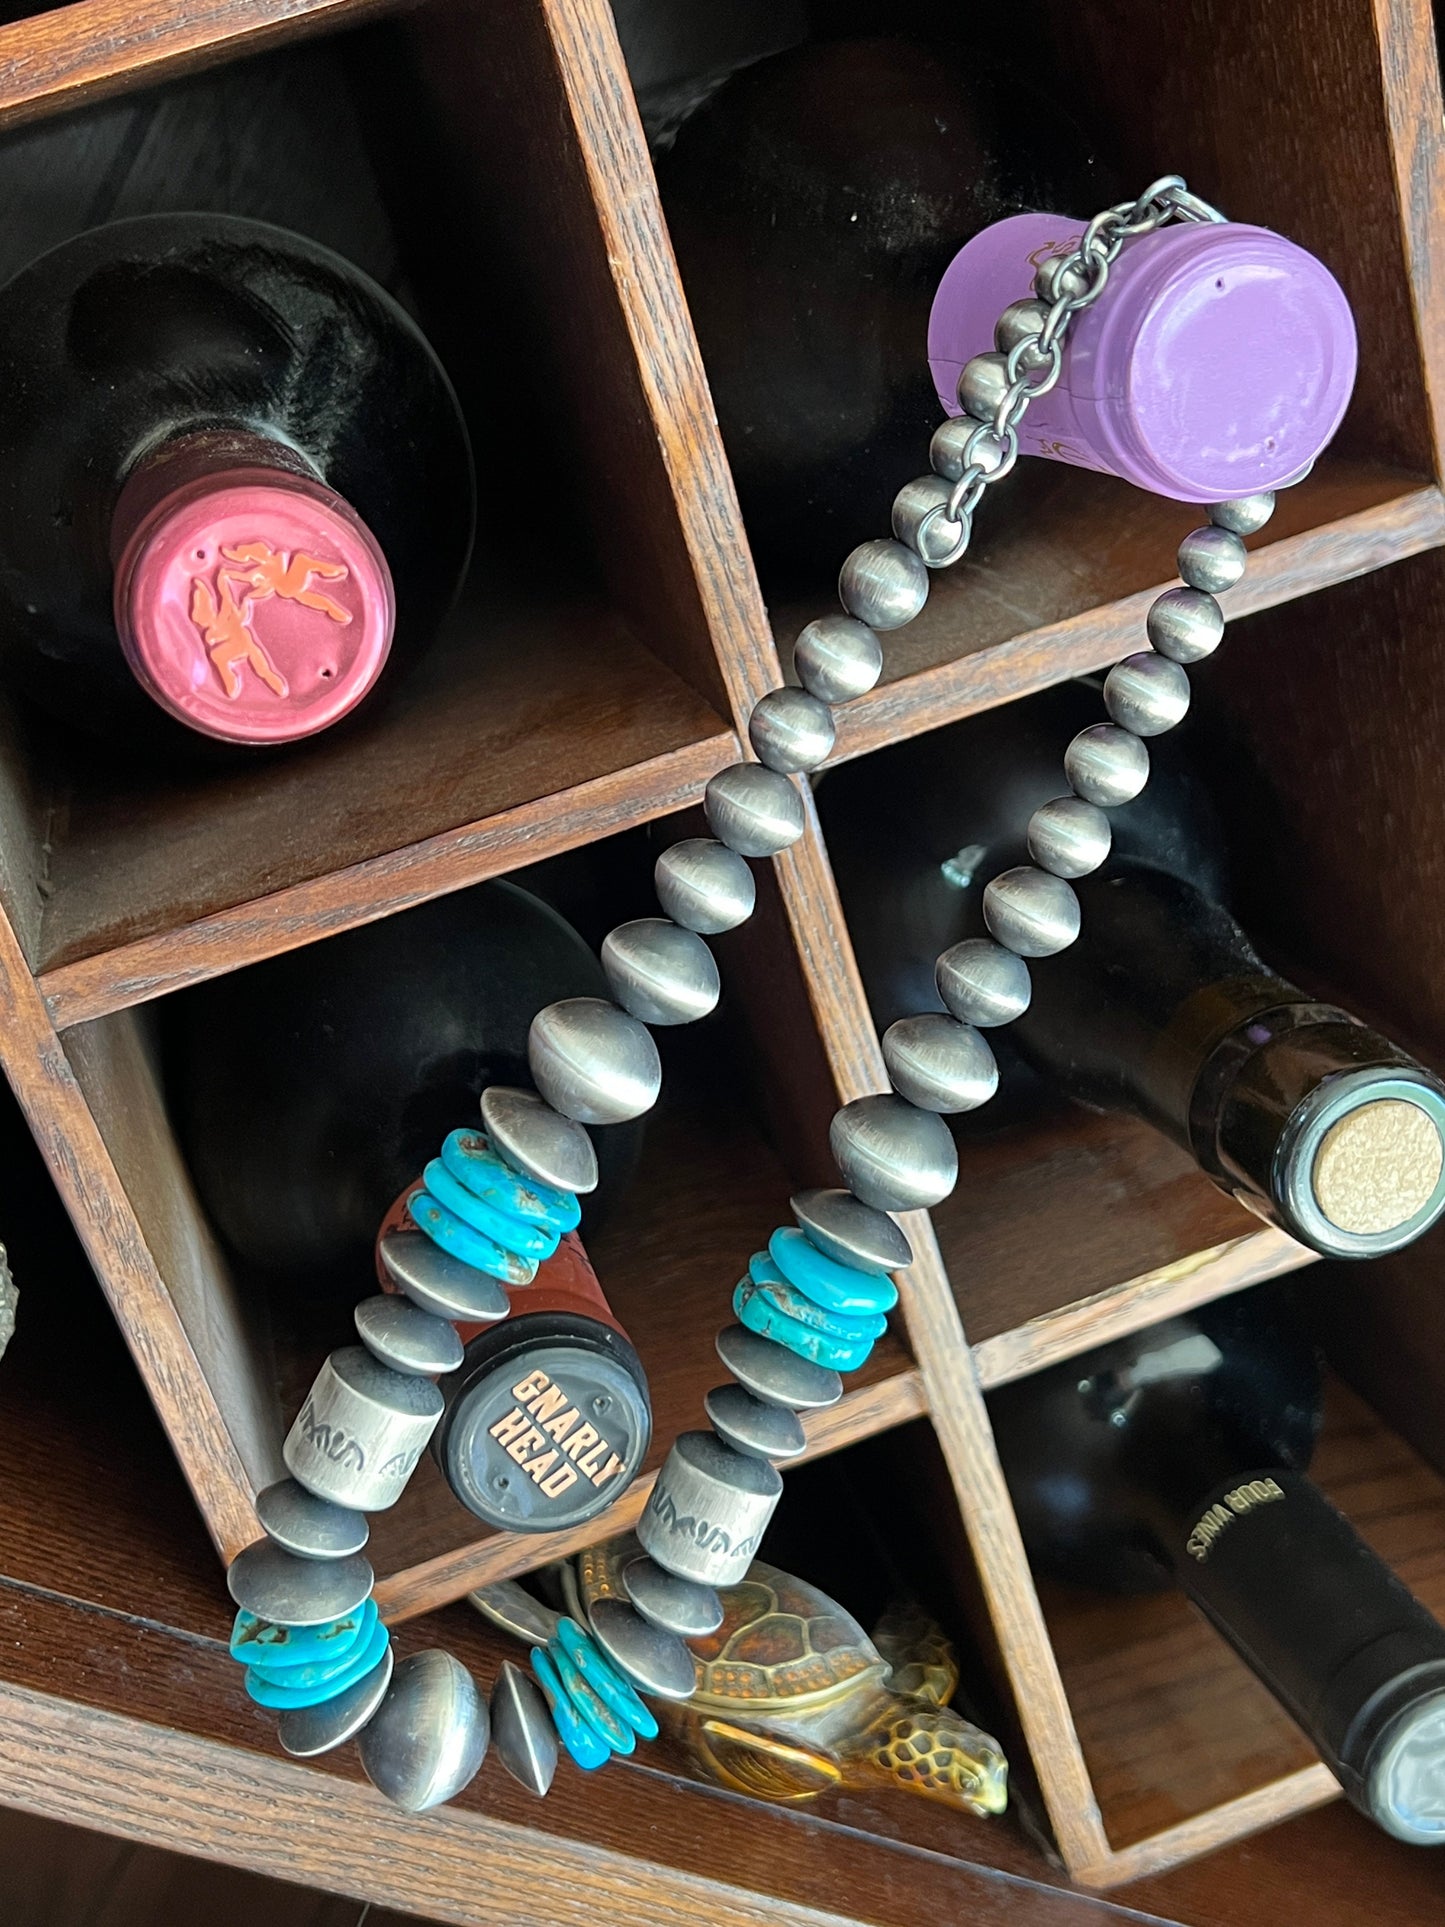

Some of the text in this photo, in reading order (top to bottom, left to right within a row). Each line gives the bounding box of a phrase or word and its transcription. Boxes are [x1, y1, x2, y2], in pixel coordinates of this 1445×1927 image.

[488, 1407, 578, 1498] HEAD
[511, 1369, 626, 1488] GNARLY
[1186, 1477, 1286, 1563] FOUR VINES
